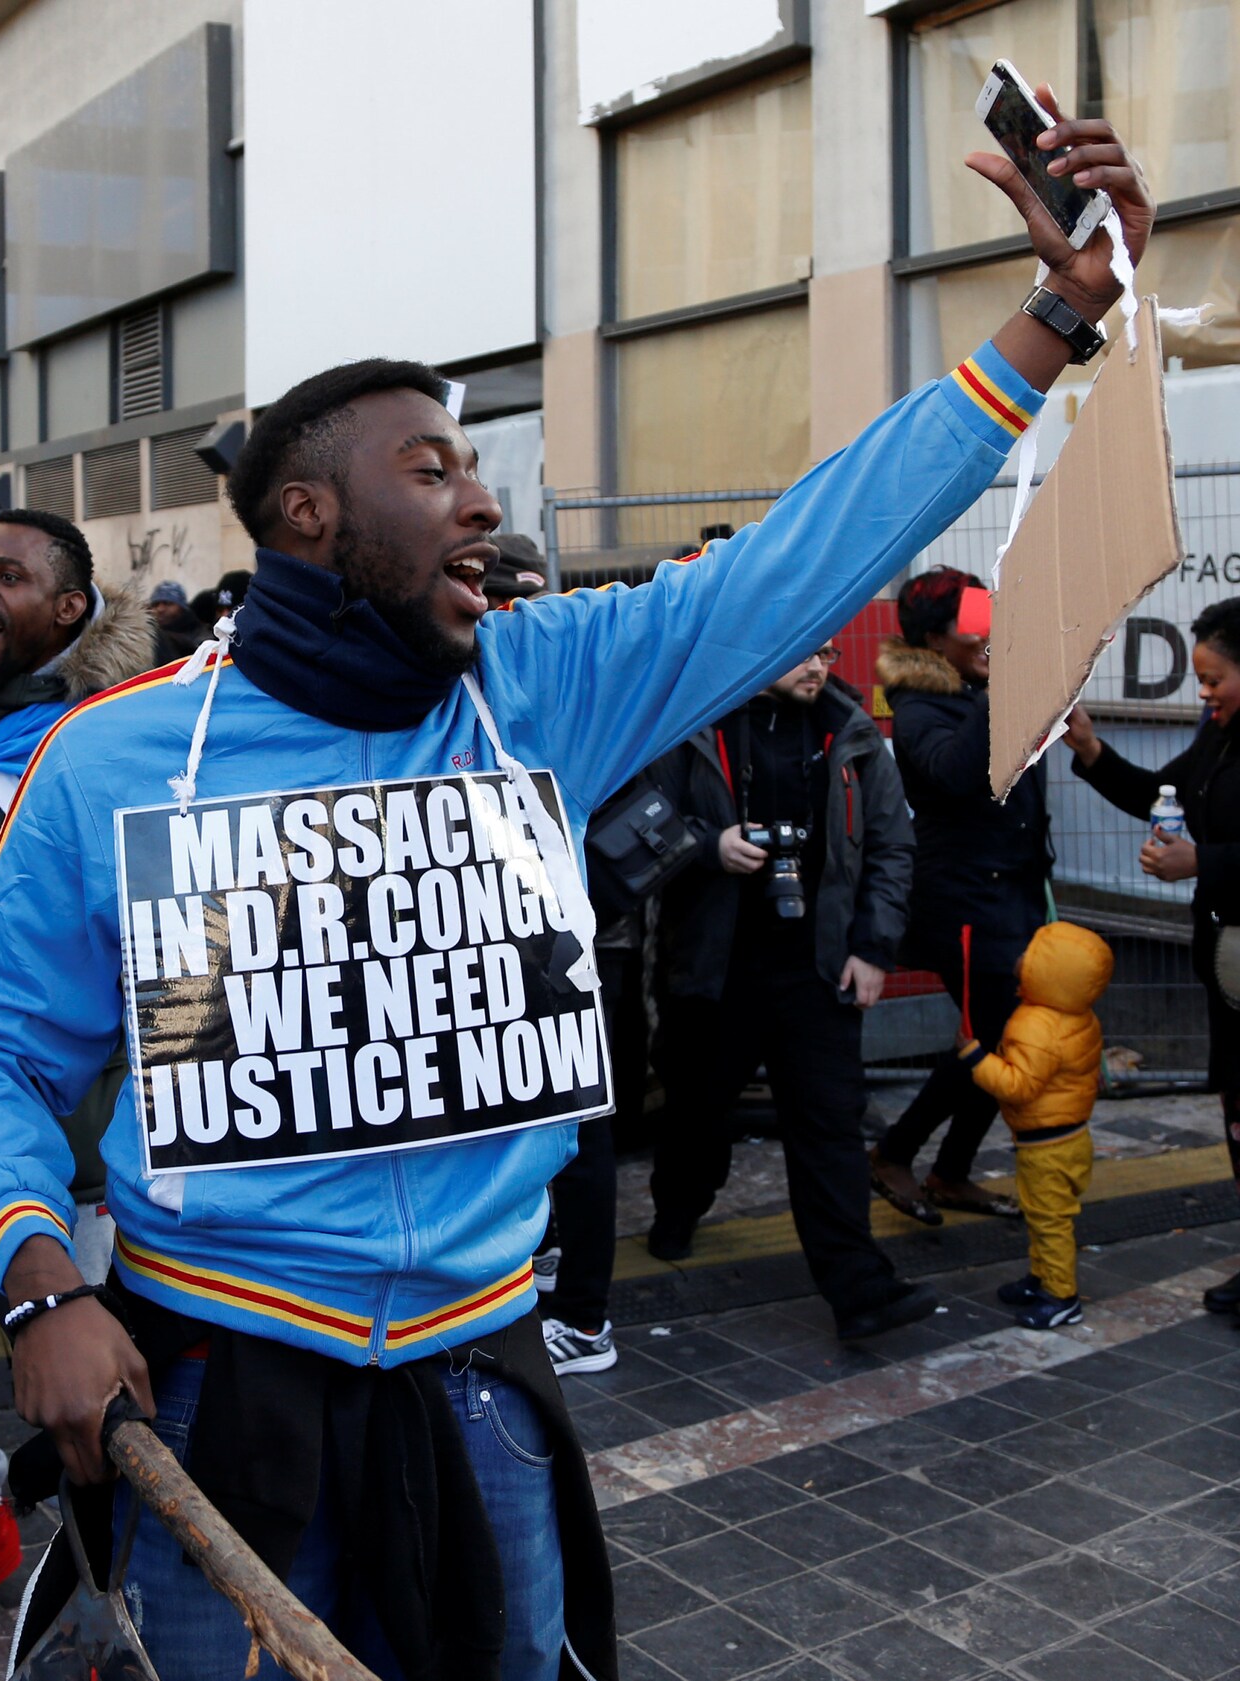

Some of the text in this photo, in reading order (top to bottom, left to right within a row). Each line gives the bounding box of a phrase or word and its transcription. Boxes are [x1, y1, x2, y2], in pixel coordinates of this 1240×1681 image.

[169, 782, 540, 894] MASSACRE
[131, 895, 209, 981] IN
[223, 943, 526, 1055] WE NEED
[150, 1008, 600, 1146] JUSTICE NOW
